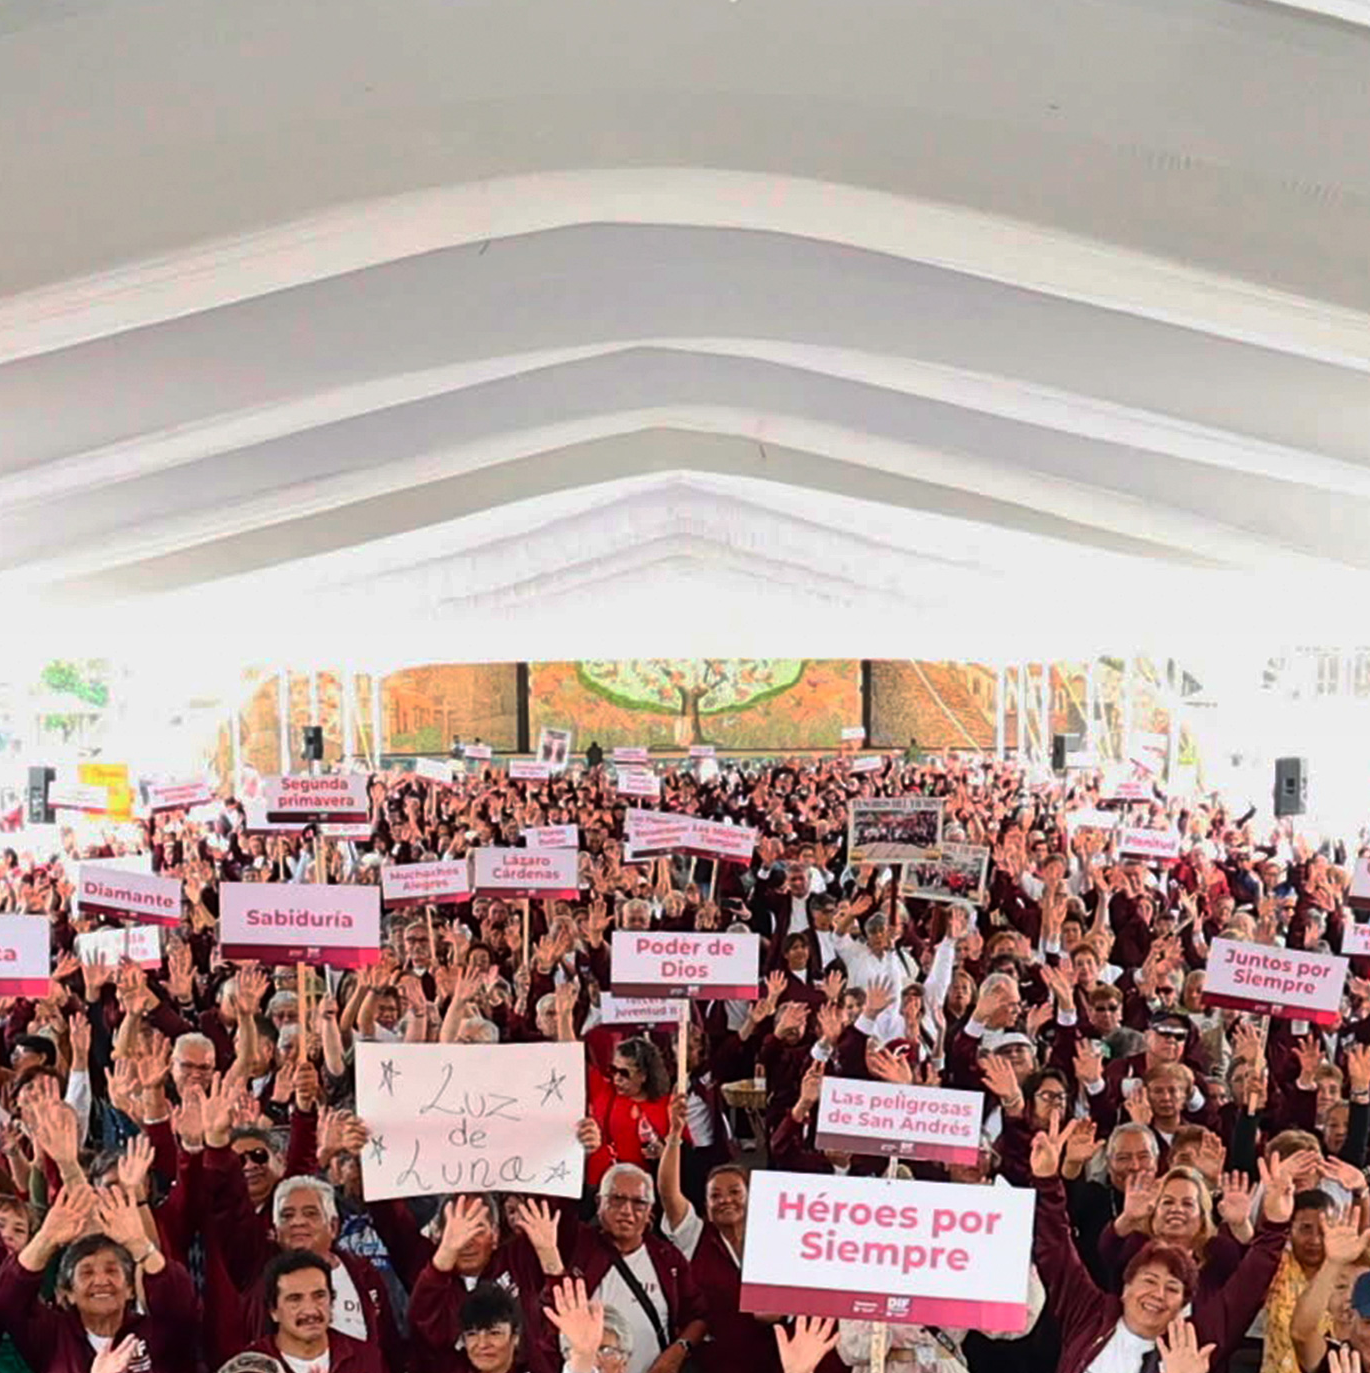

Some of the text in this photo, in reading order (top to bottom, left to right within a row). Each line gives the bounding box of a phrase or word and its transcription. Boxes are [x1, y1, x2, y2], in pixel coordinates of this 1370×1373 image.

[281, 777, 348, 793] Segunda
[277, 793, 355, 808] primavera
[84, 879, 174, 909] Diamante
[246, 909, 353, 928] Sabiduría
[636, 938, 734, 956] Poder de
[661, 960, 708, 978] Dios
[1224, 949, 1331, 983] Juntos por
[1232, 969, 1317, 995] Siempre
[419, 1063, 521, 1121] Luz
[830, 1089, 973, 1118] Las peligrosas
[448, 1119, 487, 1148] de
[828, 1108, 972, 1137] de San Andrés
[397, 1138, 537, 1191] Luna
[777, 1191, 1002, 1239] Héroes por
[799, 1230, 971, 1275] Siempre
